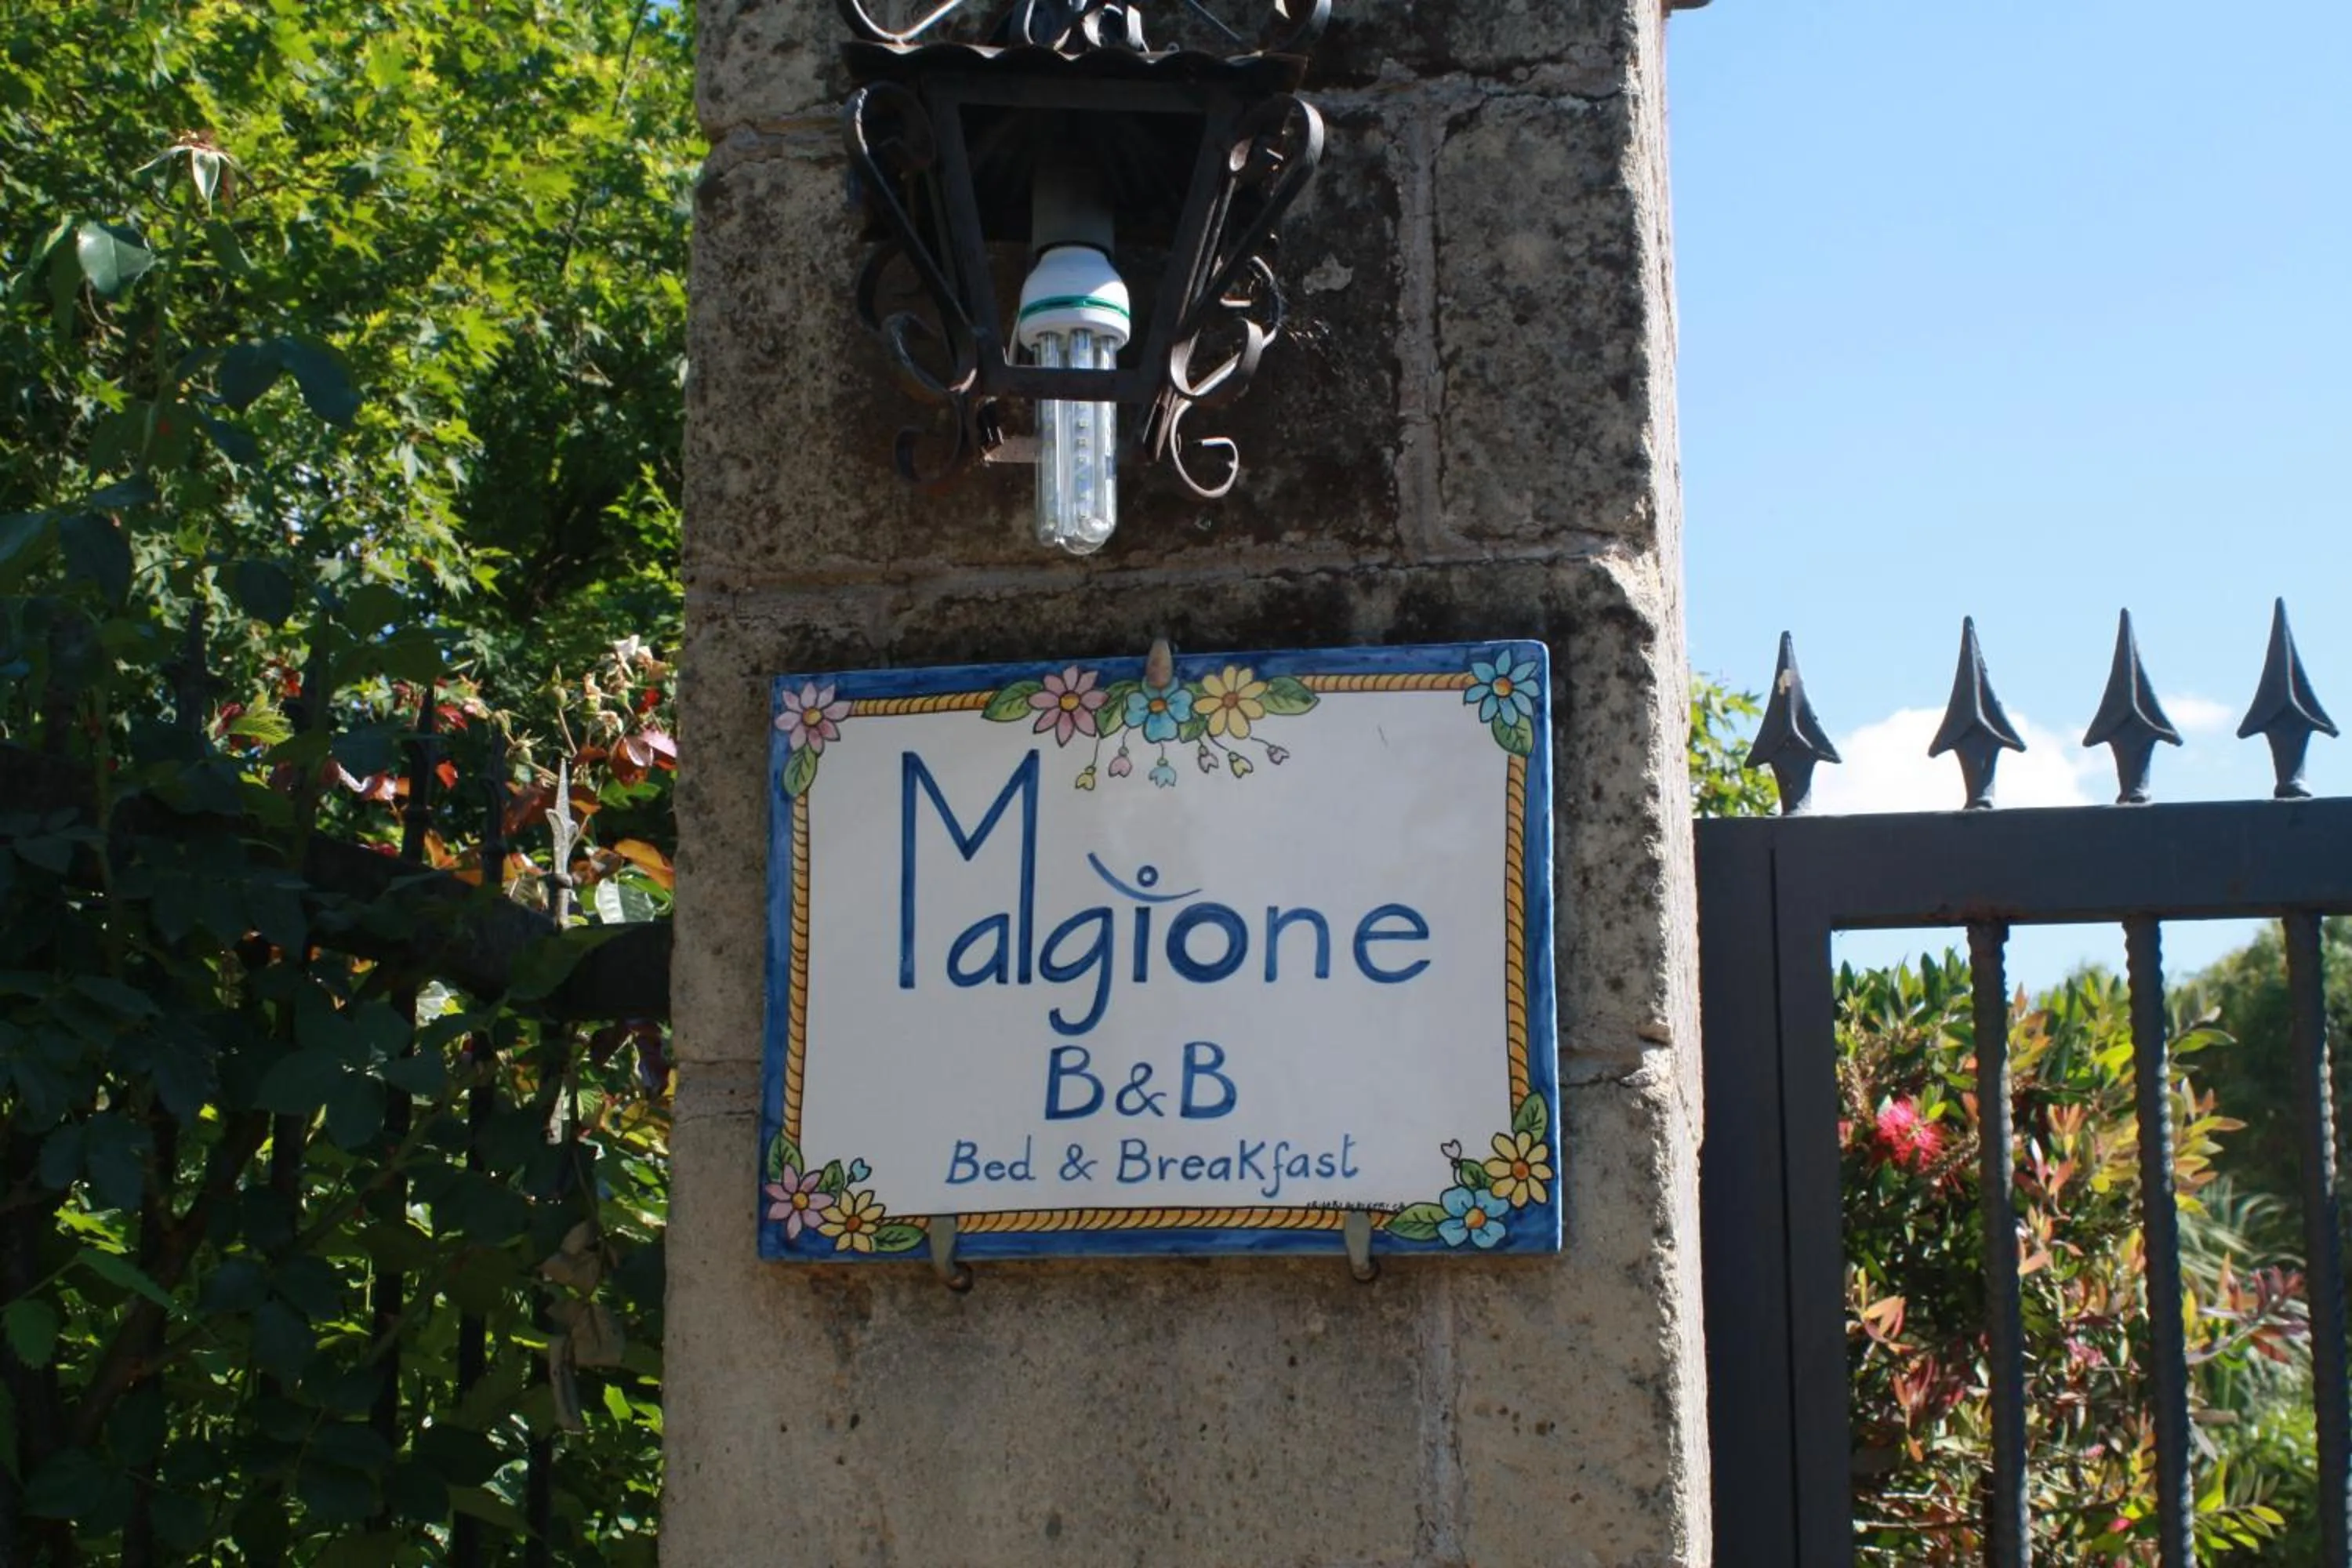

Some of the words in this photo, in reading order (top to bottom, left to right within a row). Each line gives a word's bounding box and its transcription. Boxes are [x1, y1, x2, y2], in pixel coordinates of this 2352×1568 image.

[897, 747, 1432, 1039] Malgione
[1043, 1040, 1239, 1122] B&B
[943, 1134, 1037, 1186] Bed
[1057, 1142, 1099, 1183] &
